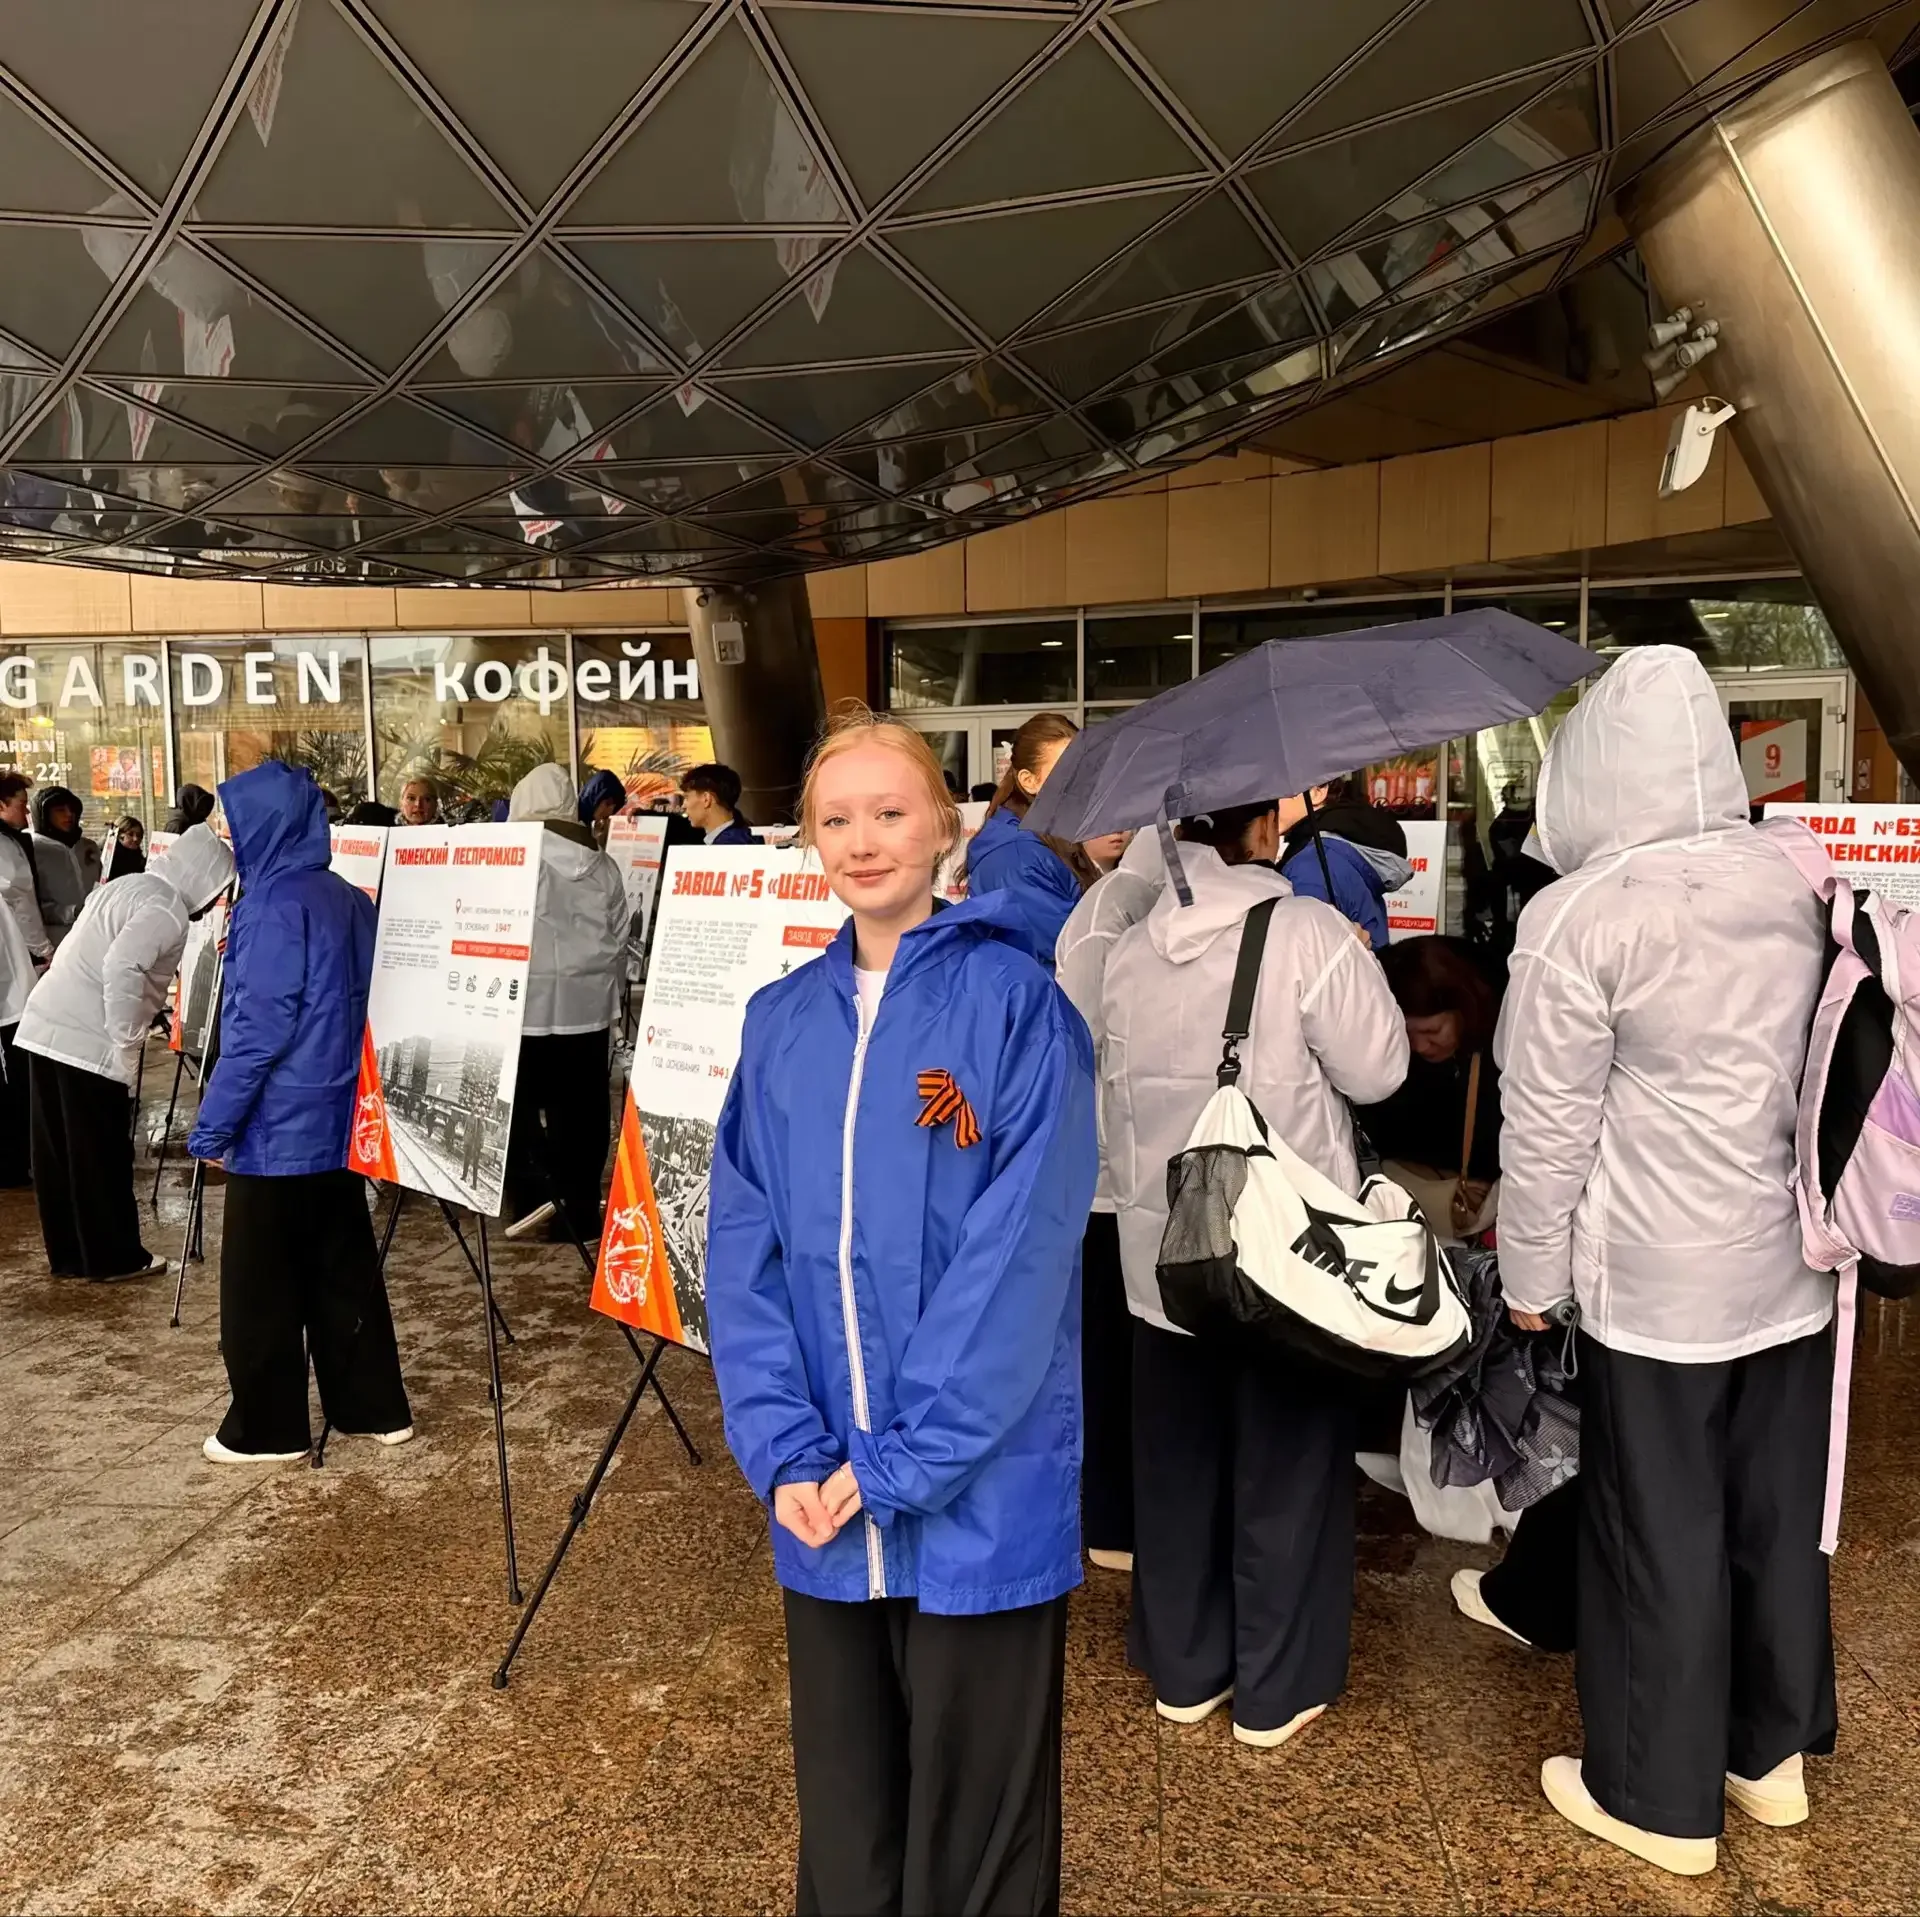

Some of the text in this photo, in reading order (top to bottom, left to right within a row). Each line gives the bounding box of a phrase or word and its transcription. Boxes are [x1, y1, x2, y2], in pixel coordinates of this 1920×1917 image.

[0, 650, 341, 708] GARDEN
[434, 641, 699, 716] кофейн
[1765, 744, 1781, 770] 9
[1797, 816, 1856, 835] ВОД
[394, 841, 526, 866] ТЮМЕНСКИЙ ЛЕСПРОМХОЗ
[1825, 840, 1920, 863] ЕНСКИЙ
[672, 871, 727, 896] ЗАВОД
[730, 869, 765, 898] №5
[788, 930, 812, 944] ЗАВОД
[708, 1064, 729, 1080] 1941
